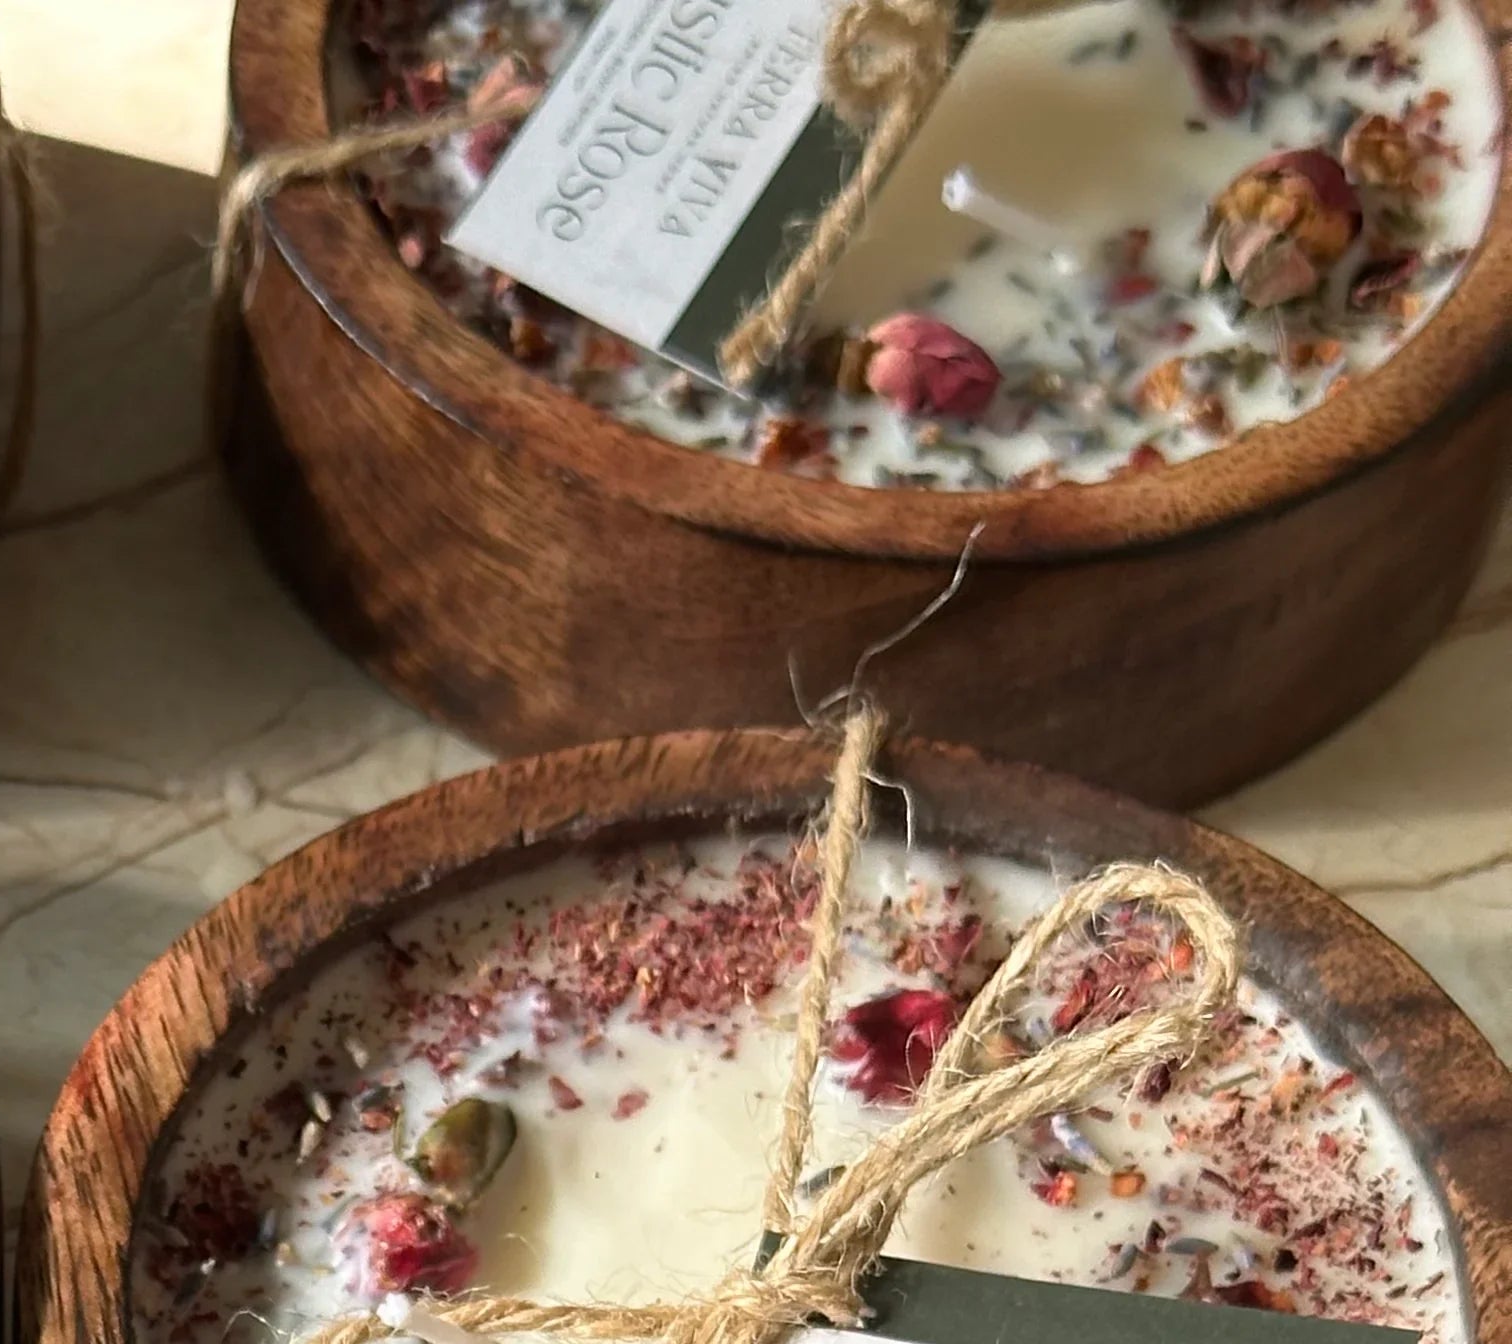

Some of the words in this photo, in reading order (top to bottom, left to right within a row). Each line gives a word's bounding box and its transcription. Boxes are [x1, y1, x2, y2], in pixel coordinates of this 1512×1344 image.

[630, 0, 729, 101] stic
[535, 98, 667, 241] Rose
[656, 150, 740, 237] VIVA
